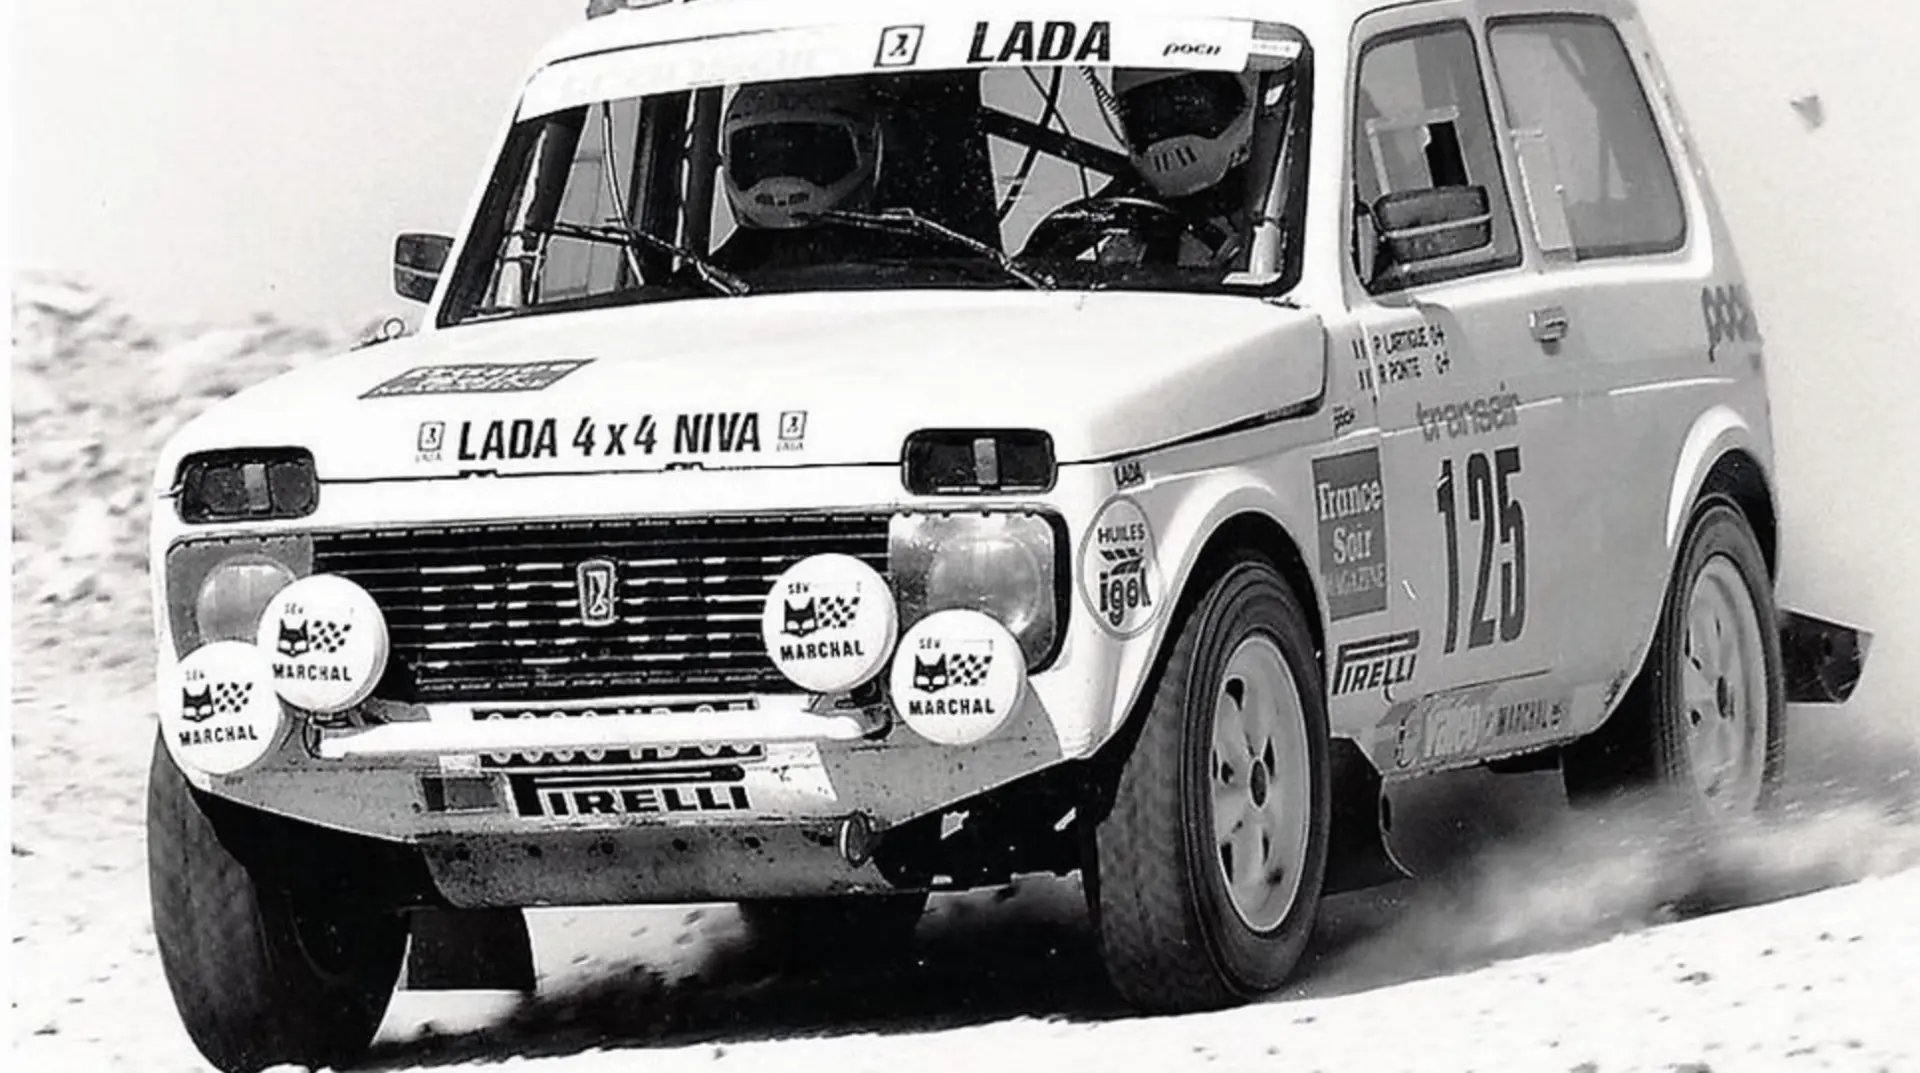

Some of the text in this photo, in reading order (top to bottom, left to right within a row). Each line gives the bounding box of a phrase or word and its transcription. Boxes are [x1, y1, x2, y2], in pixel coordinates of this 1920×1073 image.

[967, 21, 1111, 63] LADA
[458, 419, 556, 461] LADA
[673, 412, 761, 454] NIVA
[1318, 480, 1381, 521] France
[1098, 523, 1145, 544] HUILES
[1334, 523, 1372, 565] Soir
[1437, 446, 1527, 655] 125
[1100, 567, 1152, 627] igol
[780, 640, 865, 661] MARCHAL
[1332, 630, 1420, 696] PIRELLI
[272, 663, 352, 681] MARCHAL
[908, 698, 996, 716] MARCHAL
[179, 725, 258, 747] MARCHAL
[508, 764, 751, 817] PIRELLI
